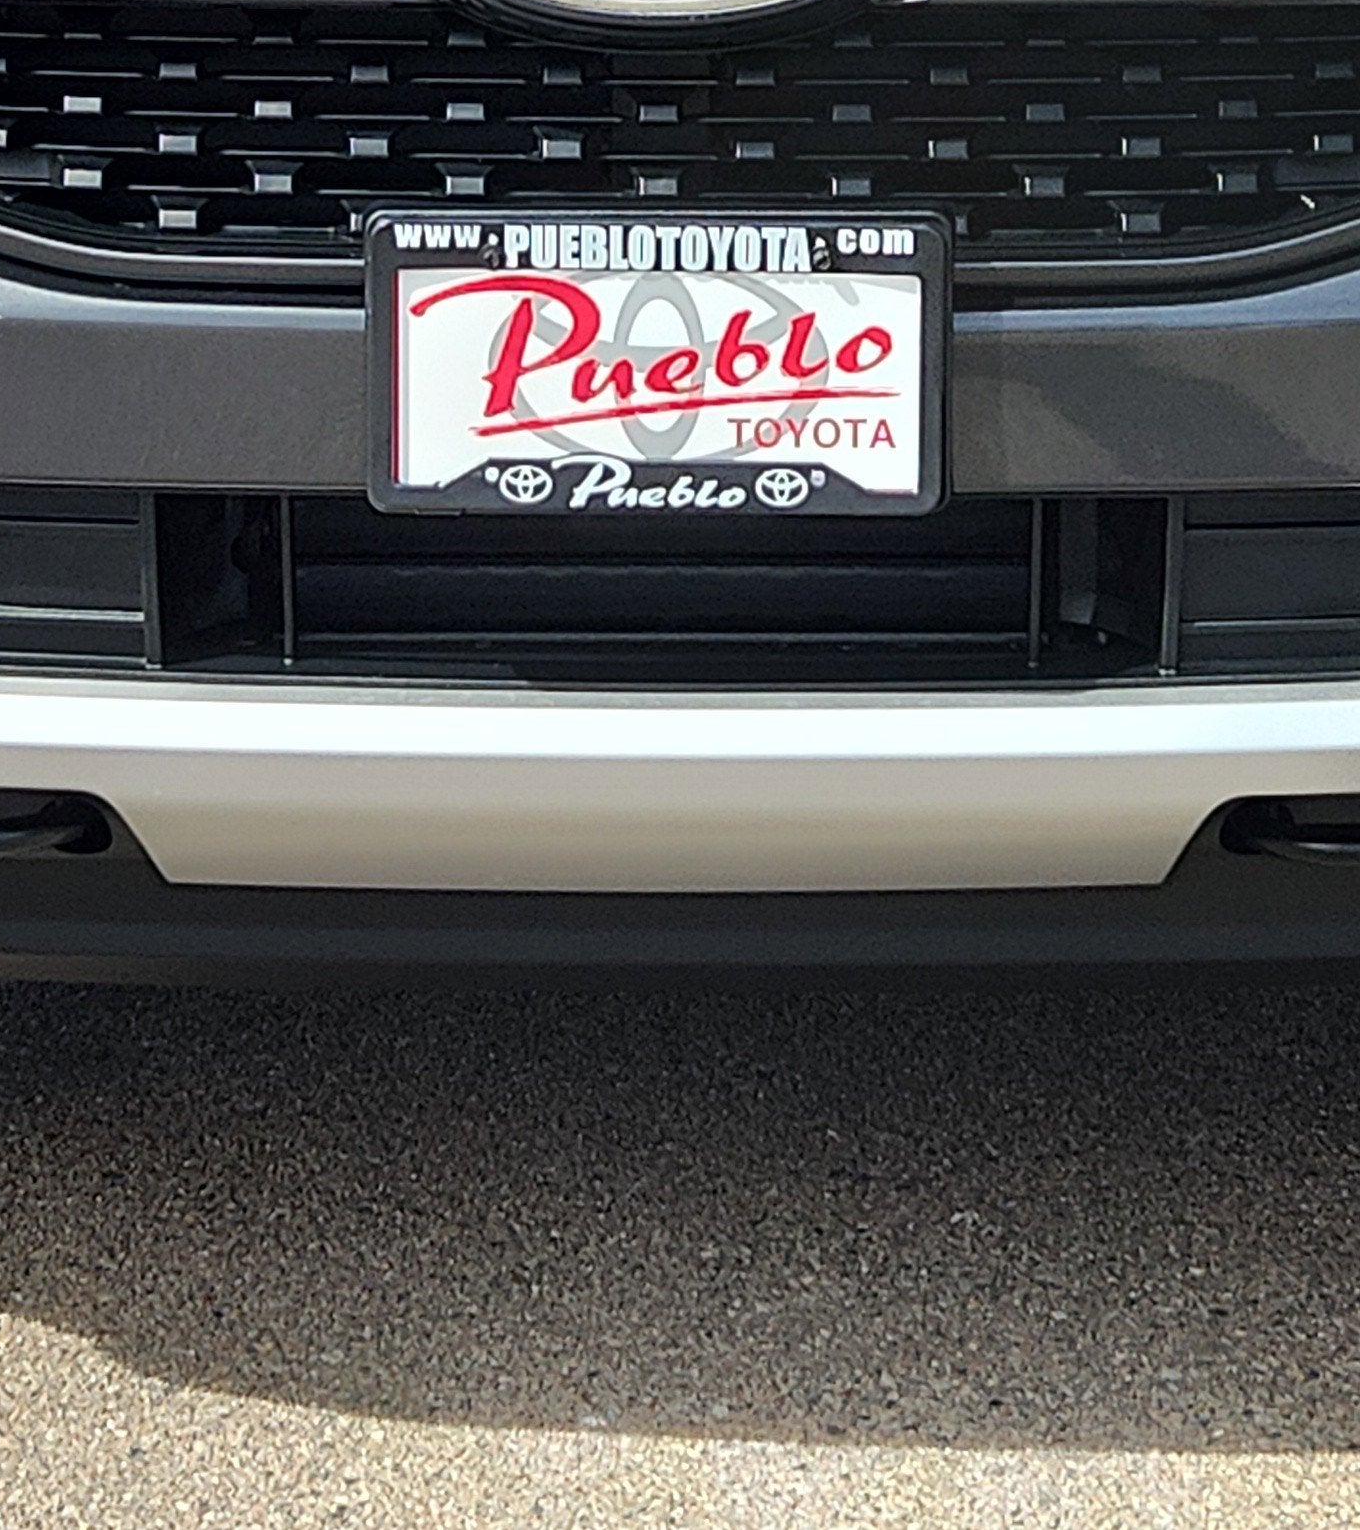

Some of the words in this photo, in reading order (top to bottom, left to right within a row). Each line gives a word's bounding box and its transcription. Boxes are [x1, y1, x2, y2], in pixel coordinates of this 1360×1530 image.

[410, 274, 893, 418] Pueblo
[728, 418, 896, 449] TOYOTA
[551, 455, 746, 510] Pueblo
